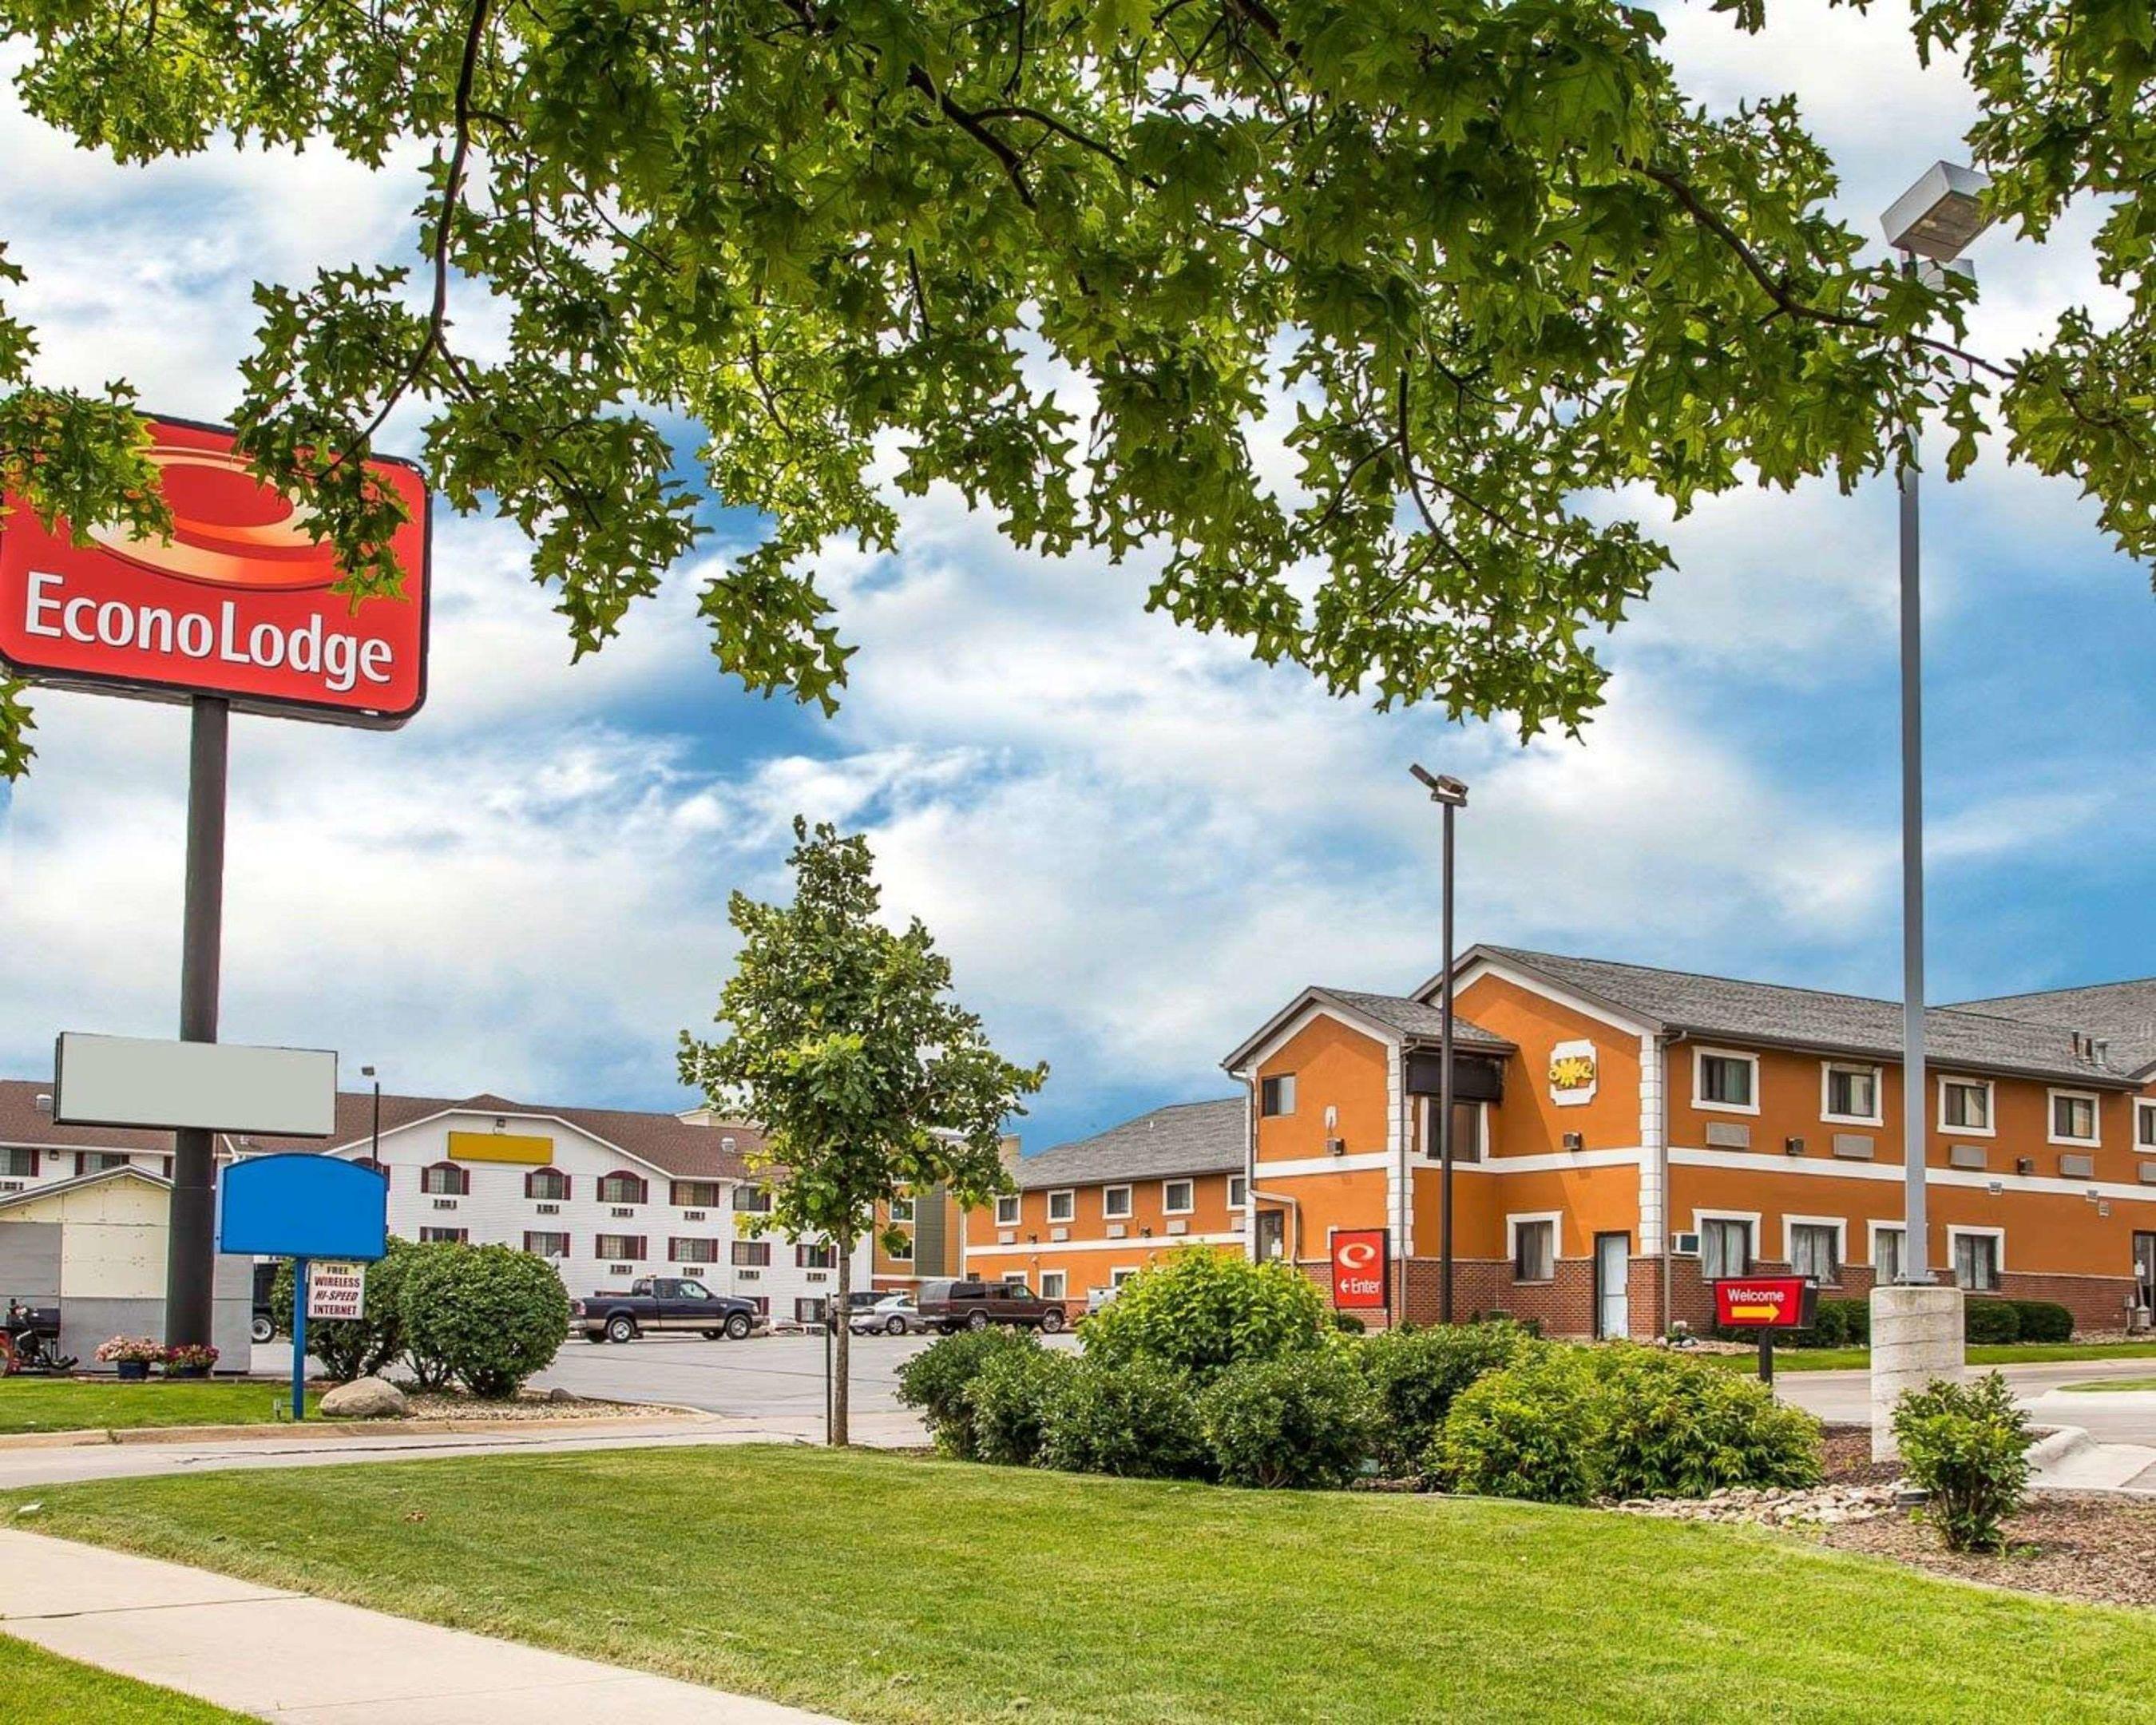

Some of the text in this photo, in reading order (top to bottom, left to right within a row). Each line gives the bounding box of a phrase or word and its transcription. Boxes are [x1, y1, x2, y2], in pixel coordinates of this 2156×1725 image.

[25, 571, 394, 692] EconoLodge
[327, 1266, 348, 1275] FREE
[315, 1276, 360, 1288] WIRELESS
[1350, 1278, 1381, 1294] Enter
[315, 1291, 359, 1301] HI-SPEED
[1727, 1288, 1785, 1302] Welcome
[314, 1304, 357, 1315] INTERNET
